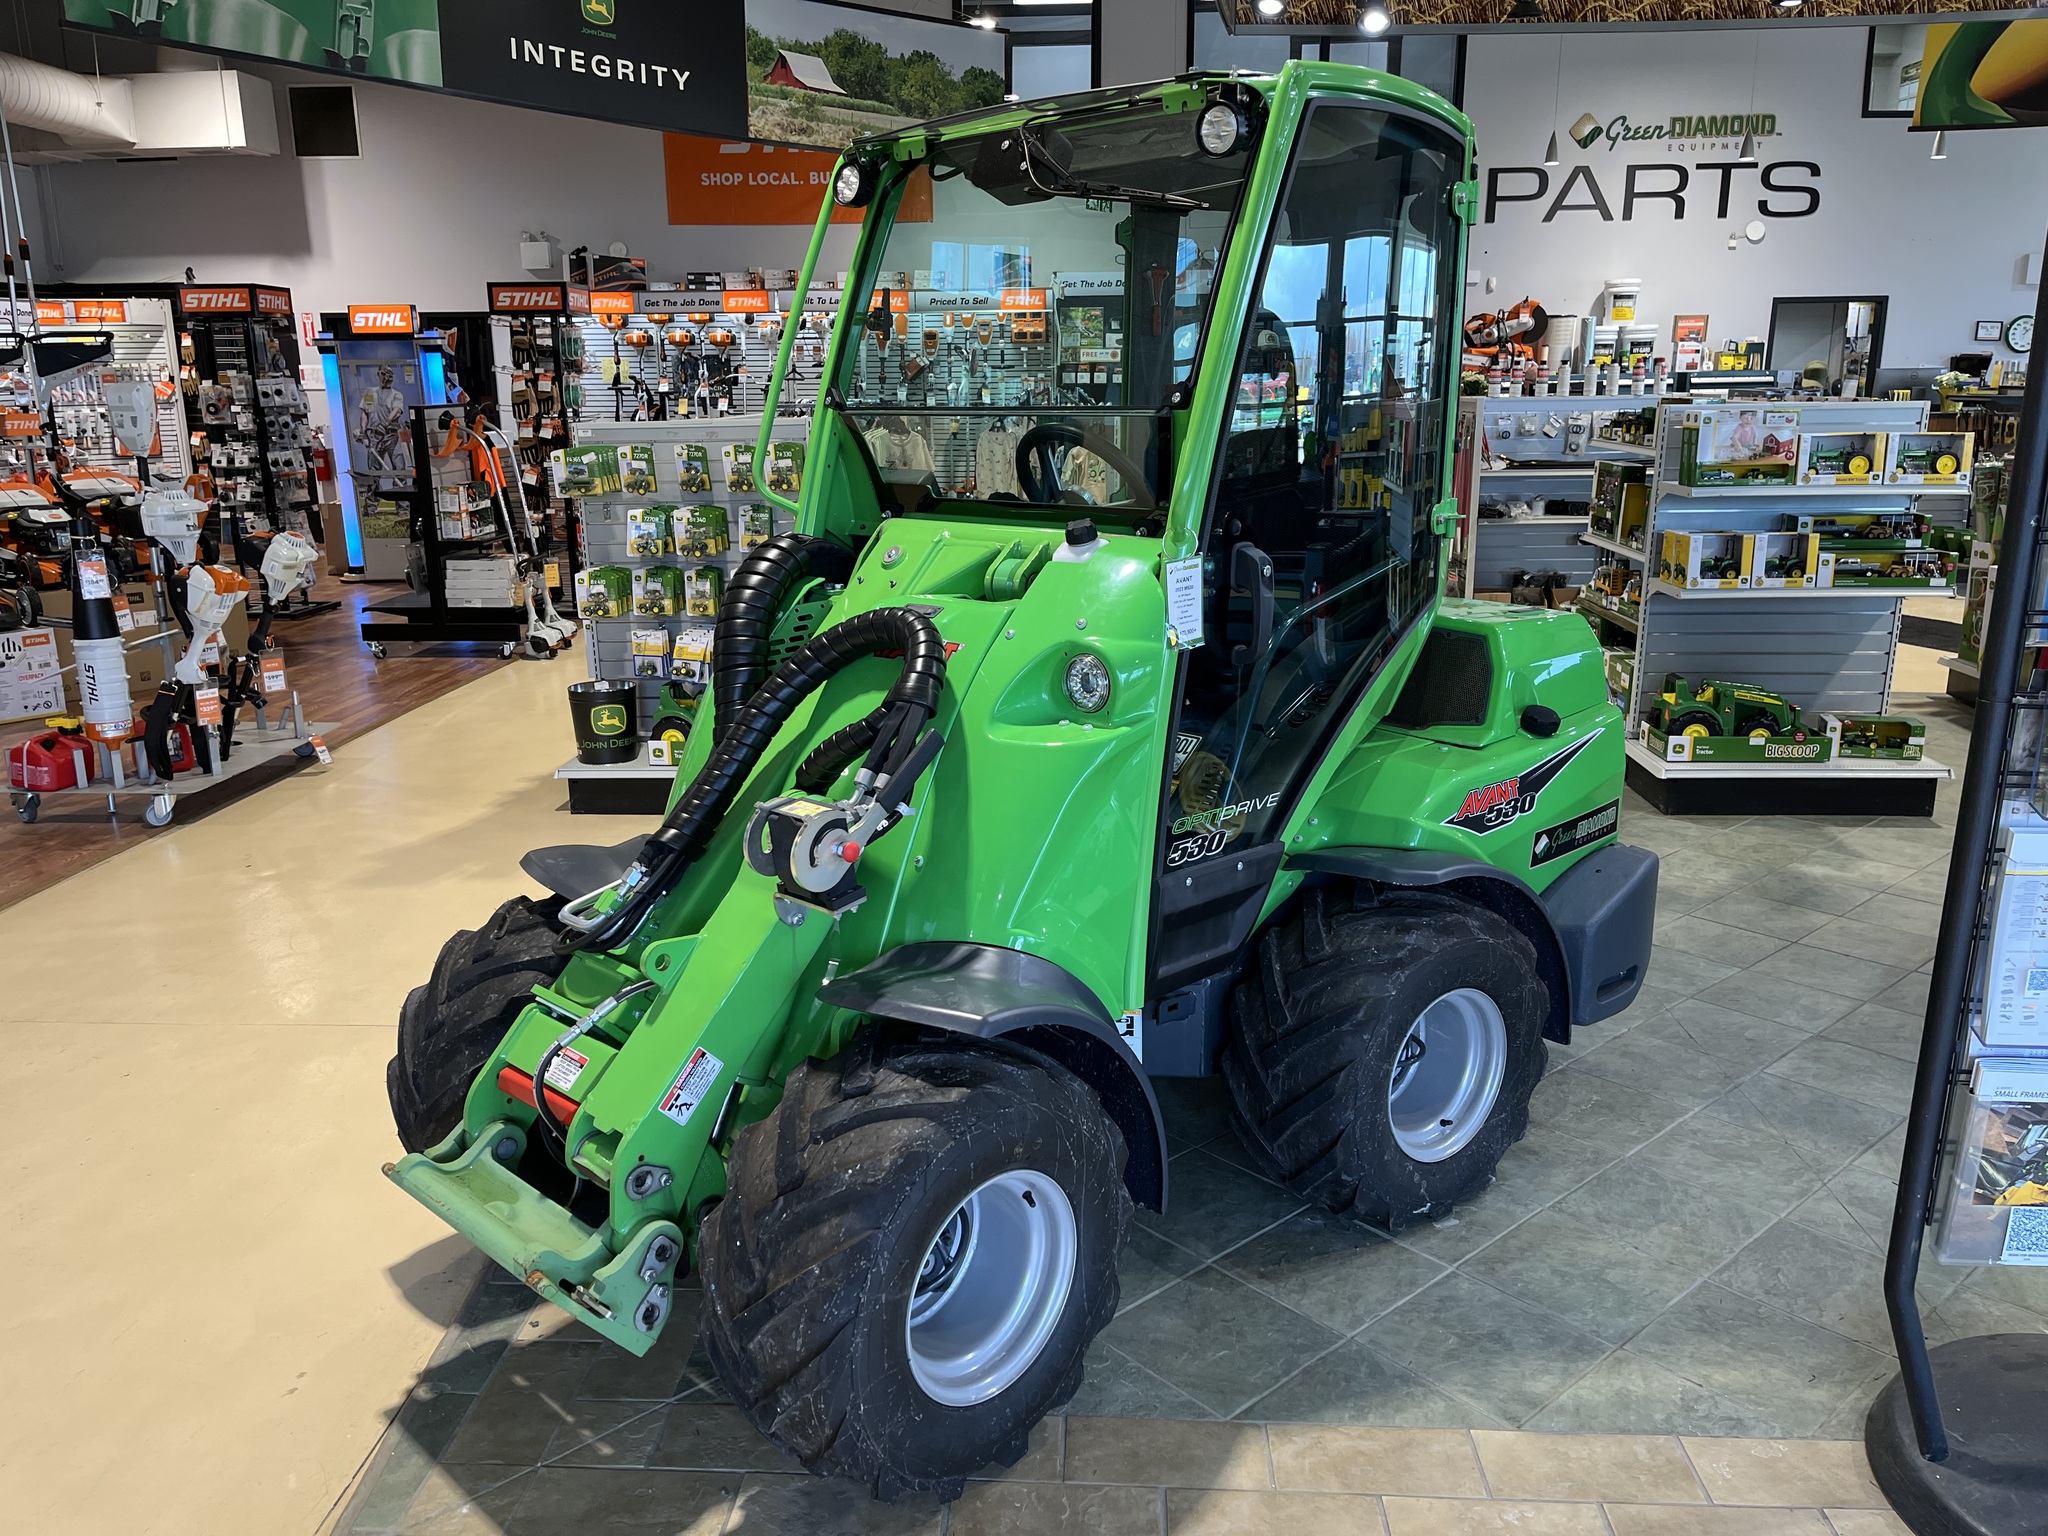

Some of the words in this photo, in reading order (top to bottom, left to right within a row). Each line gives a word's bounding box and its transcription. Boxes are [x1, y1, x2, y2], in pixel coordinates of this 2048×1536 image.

[581, 26, 598, 35] JOHN
[597, 29, 617, 40] DEERE
[510, 37, 690, 90] INTEGRITY
[1606, 114, 1671, 152] Green
[1670, 113, 1777, 139] DIAMOND
[1667, 142, 1763, 152] EQUIPMET
[701, 172, 744, 186] SHOP
[748, 172, 804, 186] LOCAL.
[809, 171, 834, 185] BU
[1484, 161, 1822, 224] PARTS
[594, 272, 620, 282] STIHL
[184, 293, 246, 308] STIHL
[258, 295, 288, 310] STIHL
[496, 292, 558, 306] STIHL
[568, 292, 588, 308] STIHL
[592, 298, 630, 308] STIHL
[698, 298, 720, 306] Done
[727, 297, 765, 306] STIHL
[972, 297, 988, 305] Sell
[1004, 296, 1042, 306] STIHL
[37, 308, 62, 318] STIHL
[80, 306, 122, 318] STIHL
[354, 312, 406, 326] STIHL
[77, 363, 96, 374] STIHL
[1176, 576, 1192, 584] AVANT
[25, 636, 48, 645] STIHL
[84, 663, 99, 706] STIHL
[610, 736, 636, 748] DEER
[1454, 776, 1520, 822] AVANT
[1172, 792, 1280, 835] OPTIDRIVE
[1484, 792, 1537, 826] 530
[1552, 826, 1577, 848] Green
[1576, 806, 1616, 838] DIAMOND
[1574, 824, 1612, 846] EQUIPMENT
[1167, 830, 1228, 866] 530
[674, 1061, 696, 1088] DANGER
